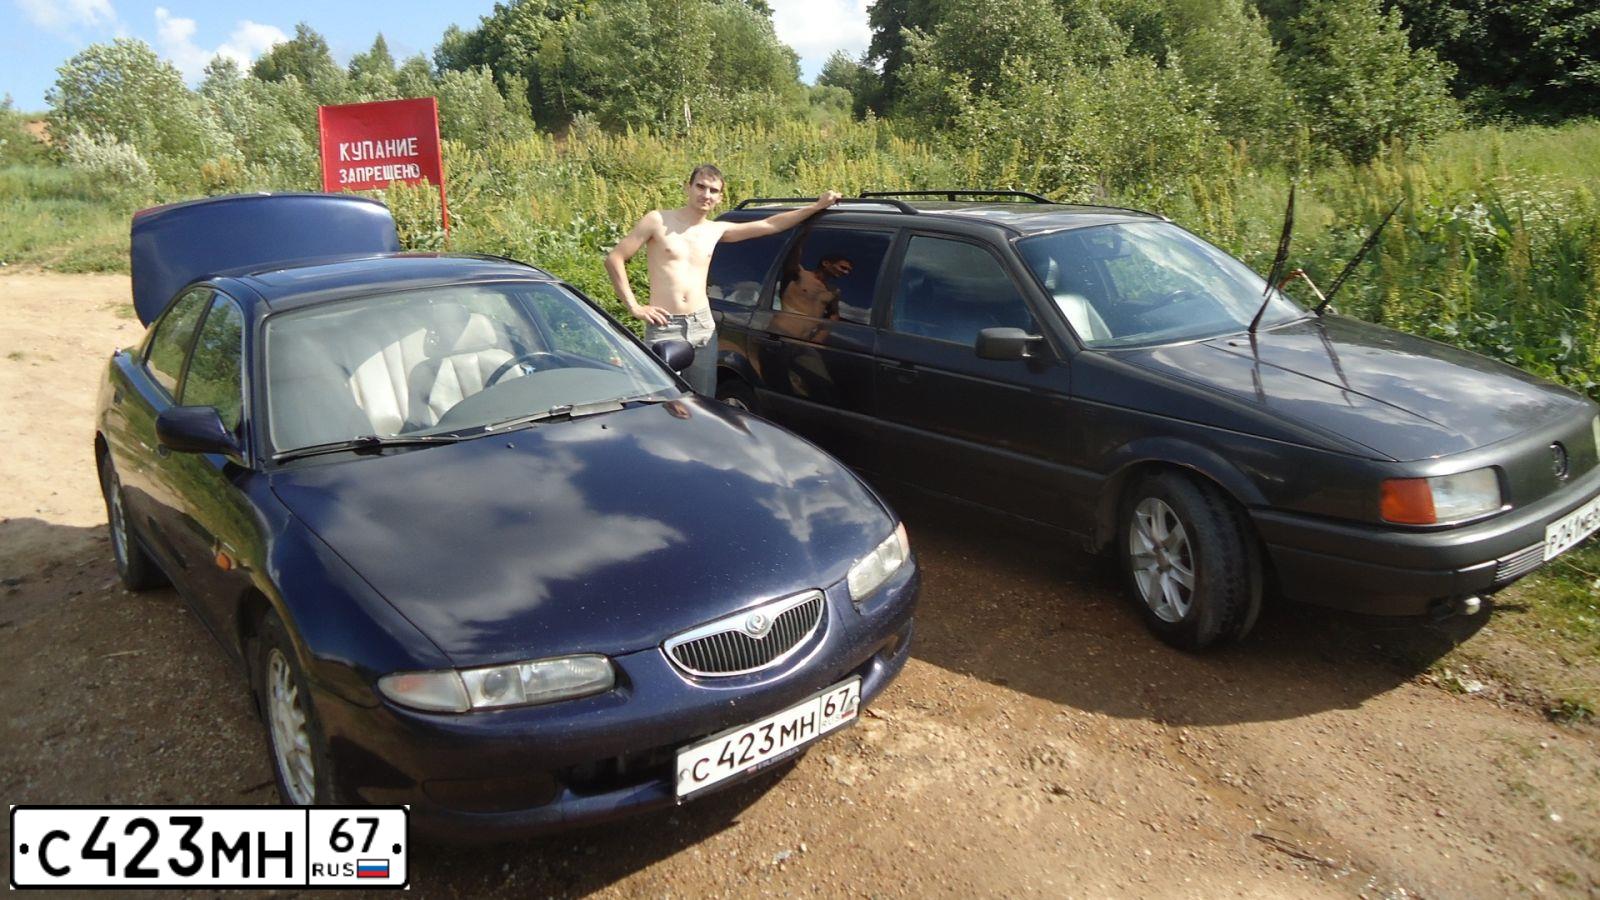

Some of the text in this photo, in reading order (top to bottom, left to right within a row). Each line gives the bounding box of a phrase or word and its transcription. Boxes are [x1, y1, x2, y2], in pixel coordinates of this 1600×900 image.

[339, 137, 419, 161] КУПАНИЕ
[339, 163, 420, 183] ЗАПРЕЩЕНО
[824, 687, 850, 718] 67
